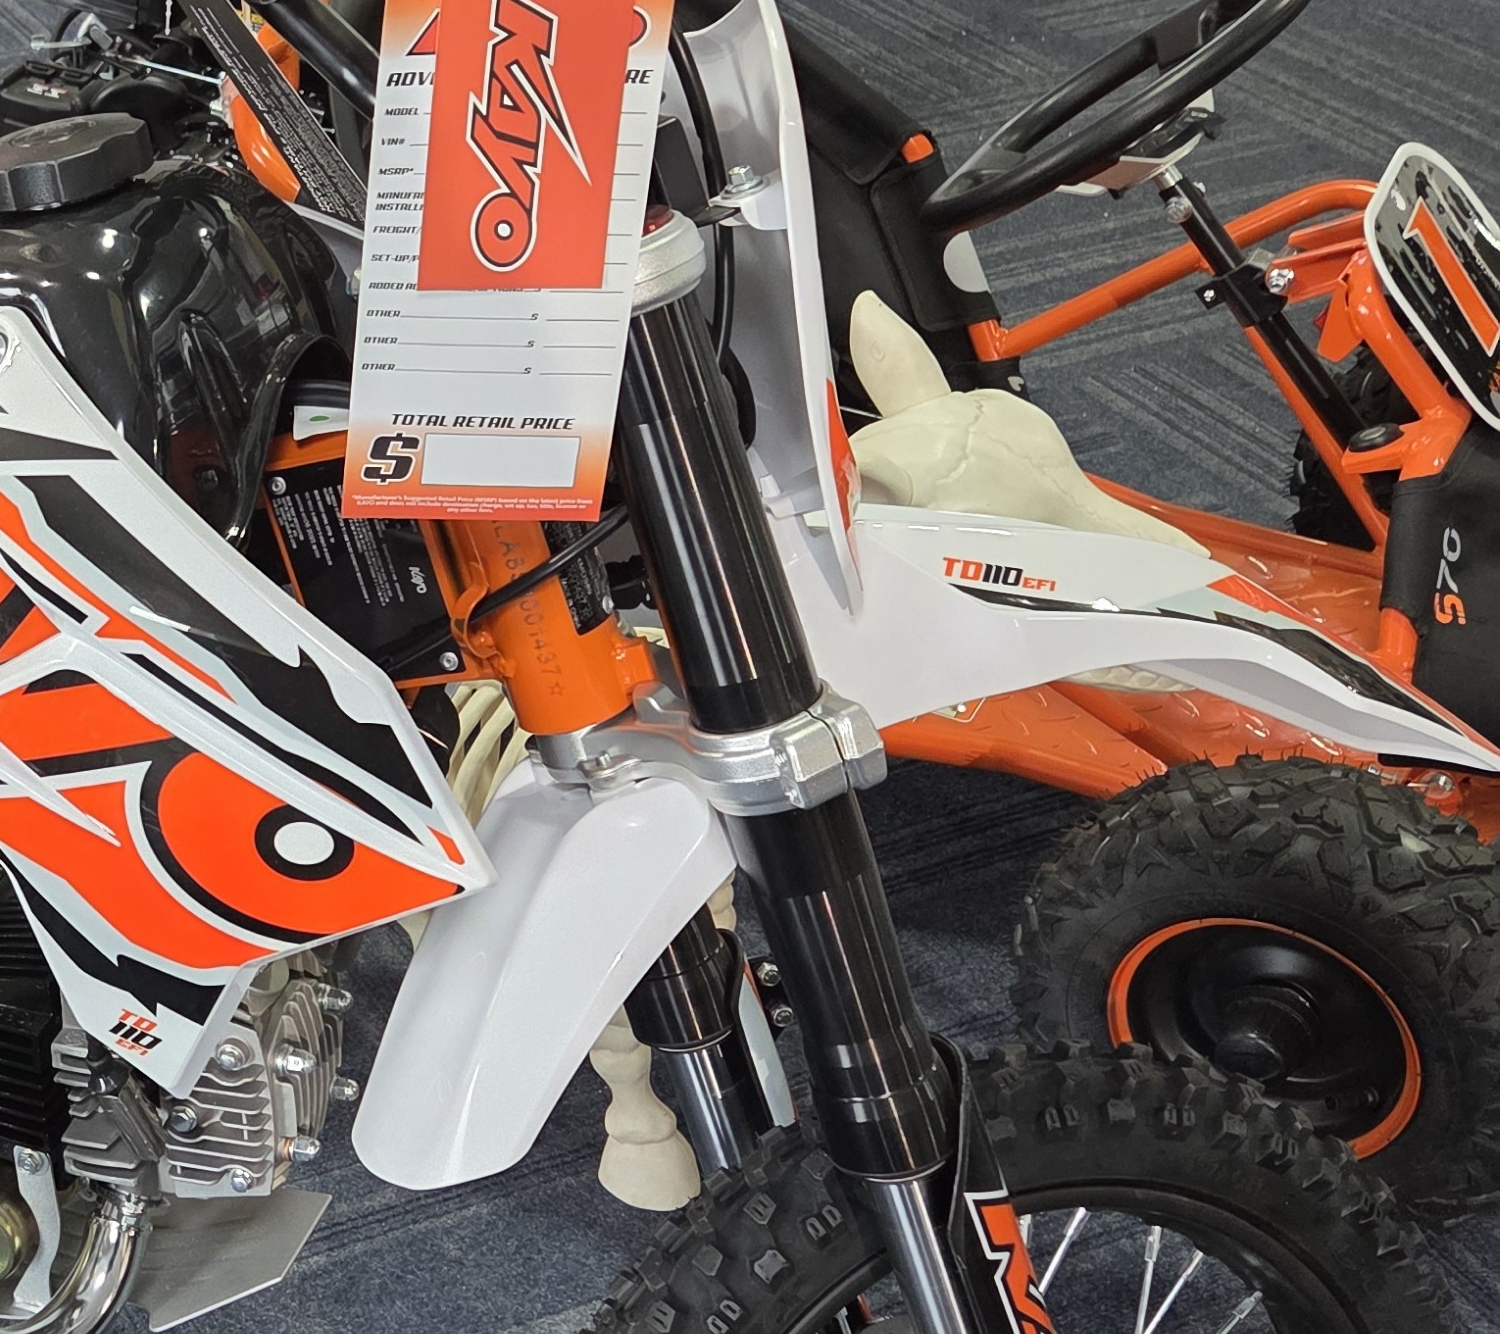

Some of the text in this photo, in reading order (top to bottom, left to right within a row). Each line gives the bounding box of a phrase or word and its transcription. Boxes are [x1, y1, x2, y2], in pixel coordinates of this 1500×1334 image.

[384, 107, 420, 116] MODEL
[381, 137, 405, 146] VIN#
[1403, 195, 1500, 358] 1
[368, 282, 404, 290] ADDED
[366, 309, 400, 317] OTHER
[363, 336, 398, 344] OTHER
[361, 363, 395, 371] OTHER
[392, 413, 576, 430] TOTAL RETAIL PRICE
[361, 432, 421, 485] $
[1433, 526, 1467, 627] S70
[119, 1008, 158, 1032] TD
[107, 1021, 164, 1050] 110
[114, 1037, 149, 1057] EFI
